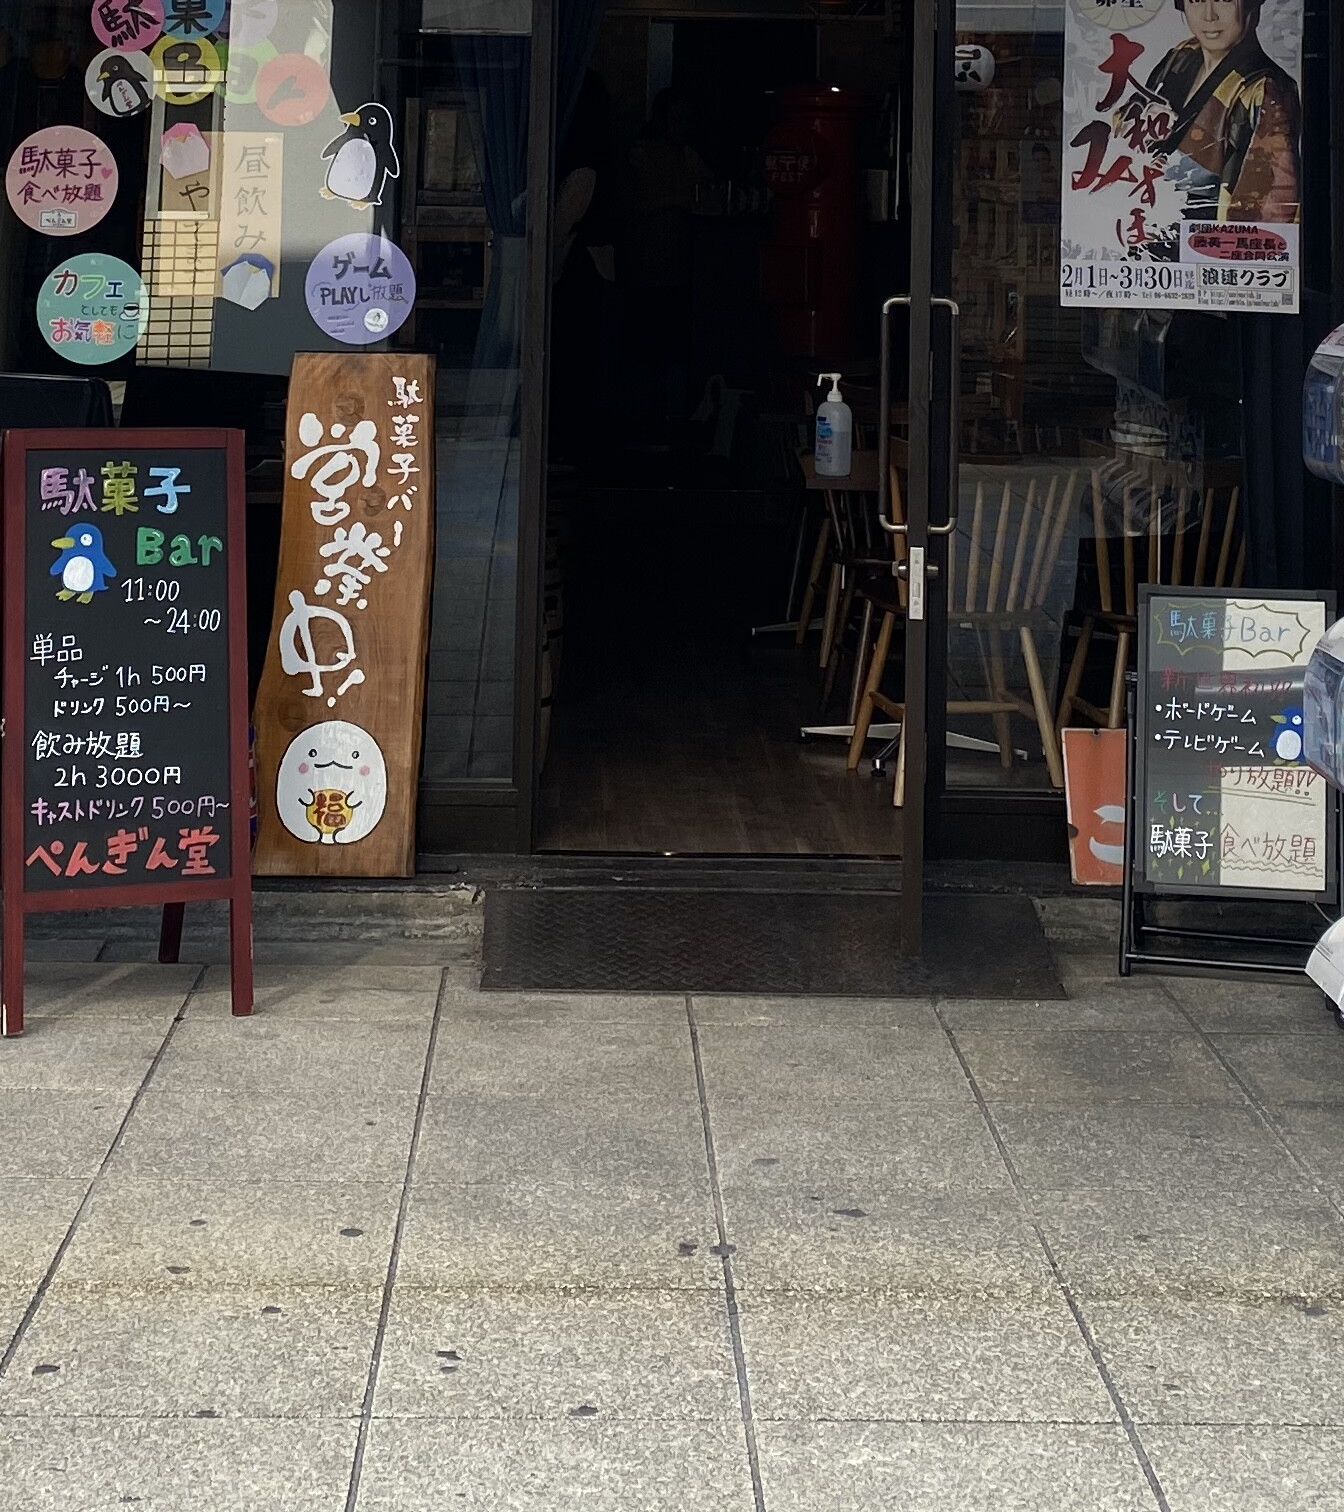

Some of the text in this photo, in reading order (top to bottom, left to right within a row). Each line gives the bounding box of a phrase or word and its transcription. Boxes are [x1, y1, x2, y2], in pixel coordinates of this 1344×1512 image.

[19, 146, 102, 180] 駄菓子
[17, 182, 104, 206] 食べ放題
[234, 145, 271, 249] 昼飲み
[1189, 223, 1259, 235] 劇団KAZUMA
[332, 251, 392, 280] ゲーム
[1218, 250, 1290, 262] 二座合同公演
[53, 269, 124, 300] カフェ
[1202, 268, 1289, 287] 浪速クラブ
[80, 304, 119, 317] としても
[50, 317, 137, 345] お気軽に
[386, 375, 423, 547] 駄菓子バー
[40, 461, 192, 516] 駄菓子
[137, 526, 224, 568] Bar
[121, 578, 180, 602] 11:00
[144, 607, 222, 634] ～24:00
[1169, 610, 1291, 644] 駄菓子Bar
[30, 633, 83, 666] 単品
[54, 664, 207, 688] チャージ 1h 500円
[53, 695, 192, 717] ドリンク 500円～
[1163, 697, 1257, 725] ボードゲーム
[31, 730, 144, 760] 飲み放題
[1162, 731, 1265, 758] テレビゲーム
[55, 766, 182, 788] 2h 3000円
[30, 796, 230, 825] キャストドリンク 500円～
[312, 791, 348, 827] 福
[25, 825, 221, 877] ぺんぎん堂
[1150, 822, 1317, 864] 駄菓子 食べ放題
